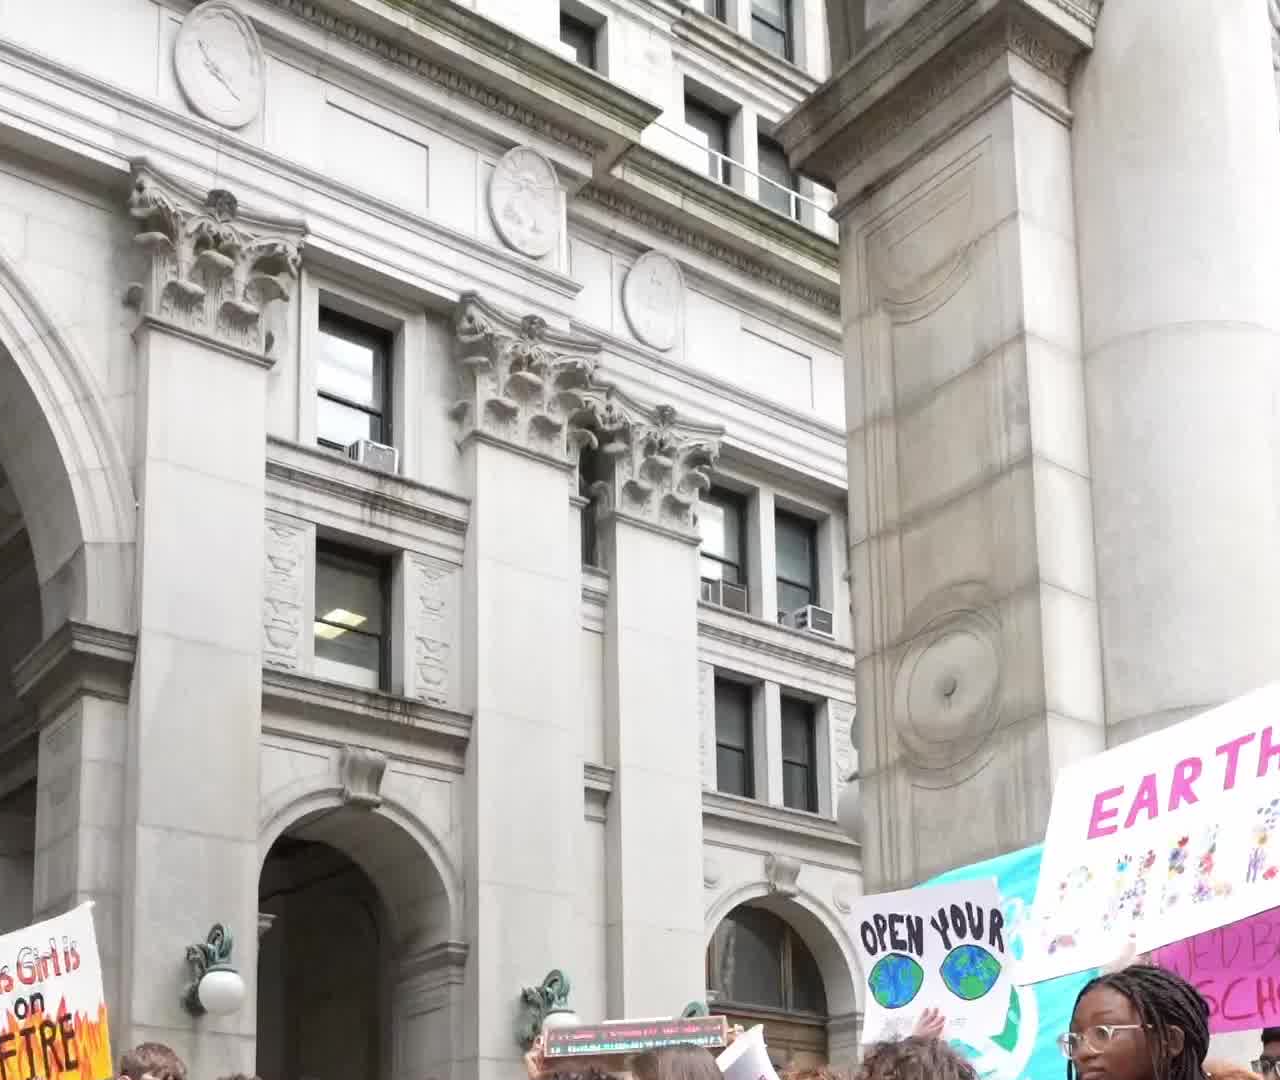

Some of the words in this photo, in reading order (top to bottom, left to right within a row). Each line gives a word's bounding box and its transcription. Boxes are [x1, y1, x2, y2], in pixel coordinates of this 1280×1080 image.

[860, 913, 924, 957] OPEN
[930, 901, 1005, 953] YOUR
[17, 938, 62, 985] Girl
[62, 936, 81, 974] is
[14, 992, 45, 1020] on
